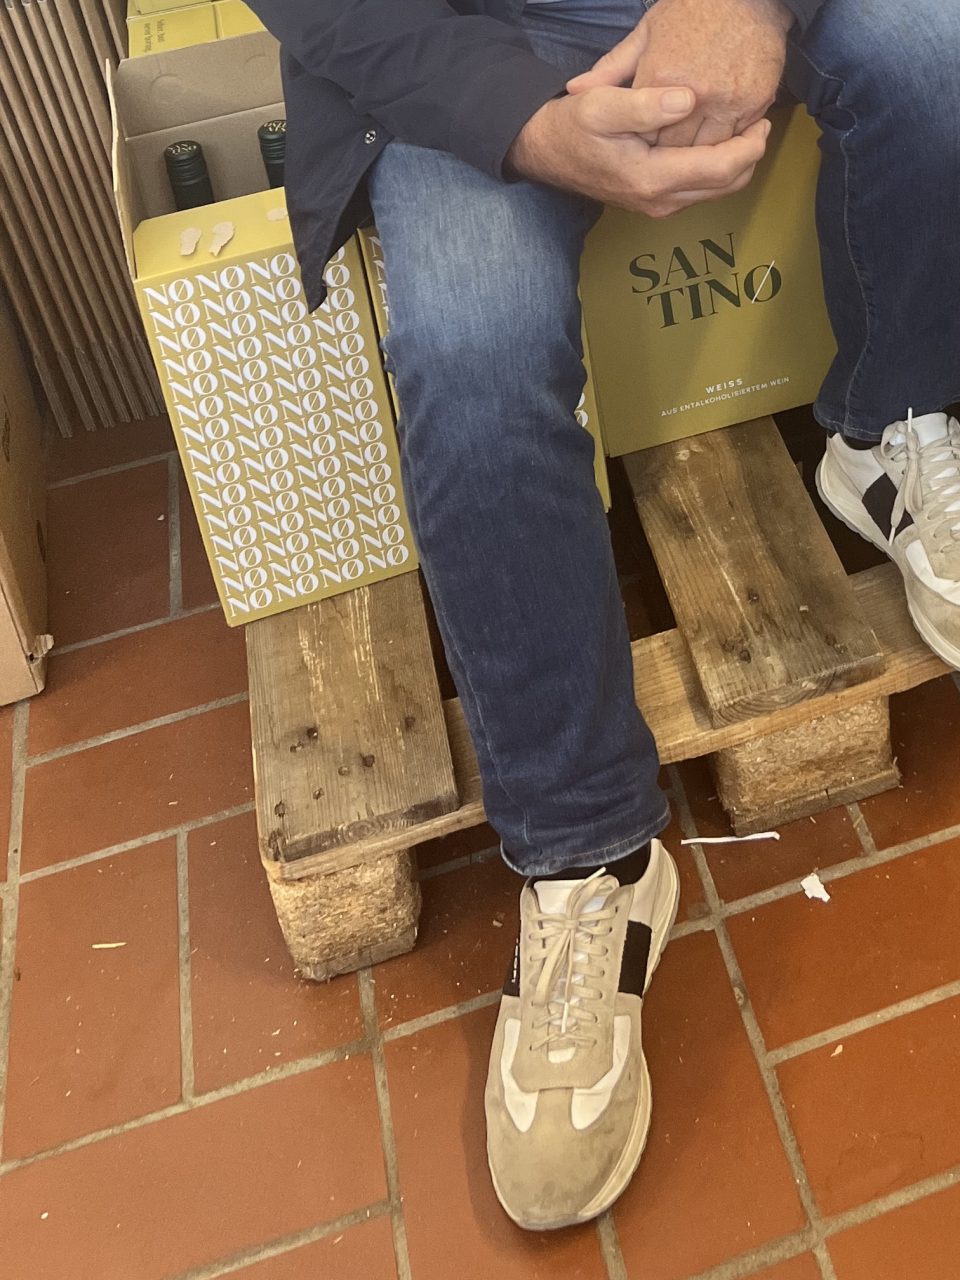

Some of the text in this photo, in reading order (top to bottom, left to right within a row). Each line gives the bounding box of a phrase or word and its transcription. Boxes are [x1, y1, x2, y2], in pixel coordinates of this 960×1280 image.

[629, 232, 735, 294] SAN
[661, 377, 790, 417] AUS ENTALKOHOLISIERTEM WEIN
[705, 378, 743, 394] WEISS
